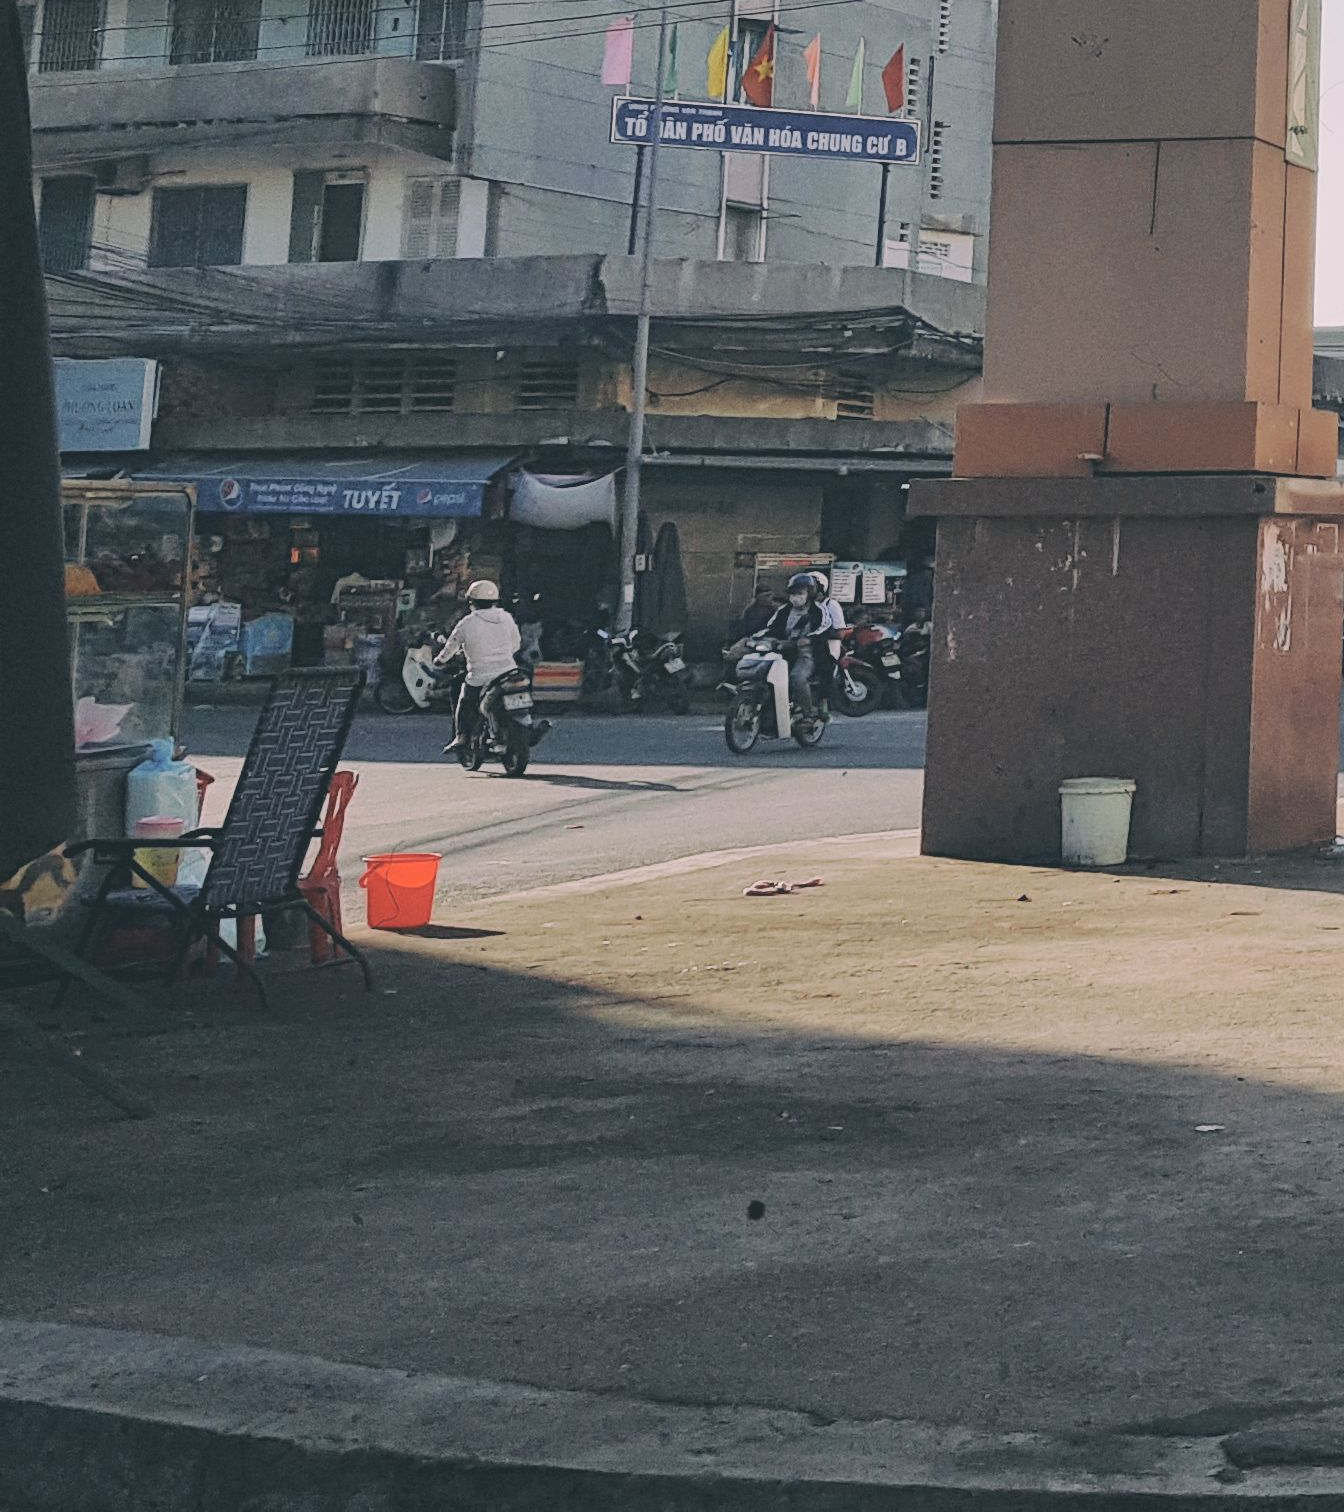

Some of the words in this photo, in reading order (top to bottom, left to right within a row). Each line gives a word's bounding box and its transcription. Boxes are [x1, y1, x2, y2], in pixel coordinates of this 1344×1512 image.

[625, 111, 648, 137] TỔ
[692, 118, 729, 143] PHỐ
[731, 123, 764, 146] VĂN
[769, 126, 802, 149] HÓA
[807, 131, 862, 154] CHUNG
[866, 134, 892, 155] CƯ
[896, 138, 907, 156] B
[342, 483, 401, 509] TUYẾT
